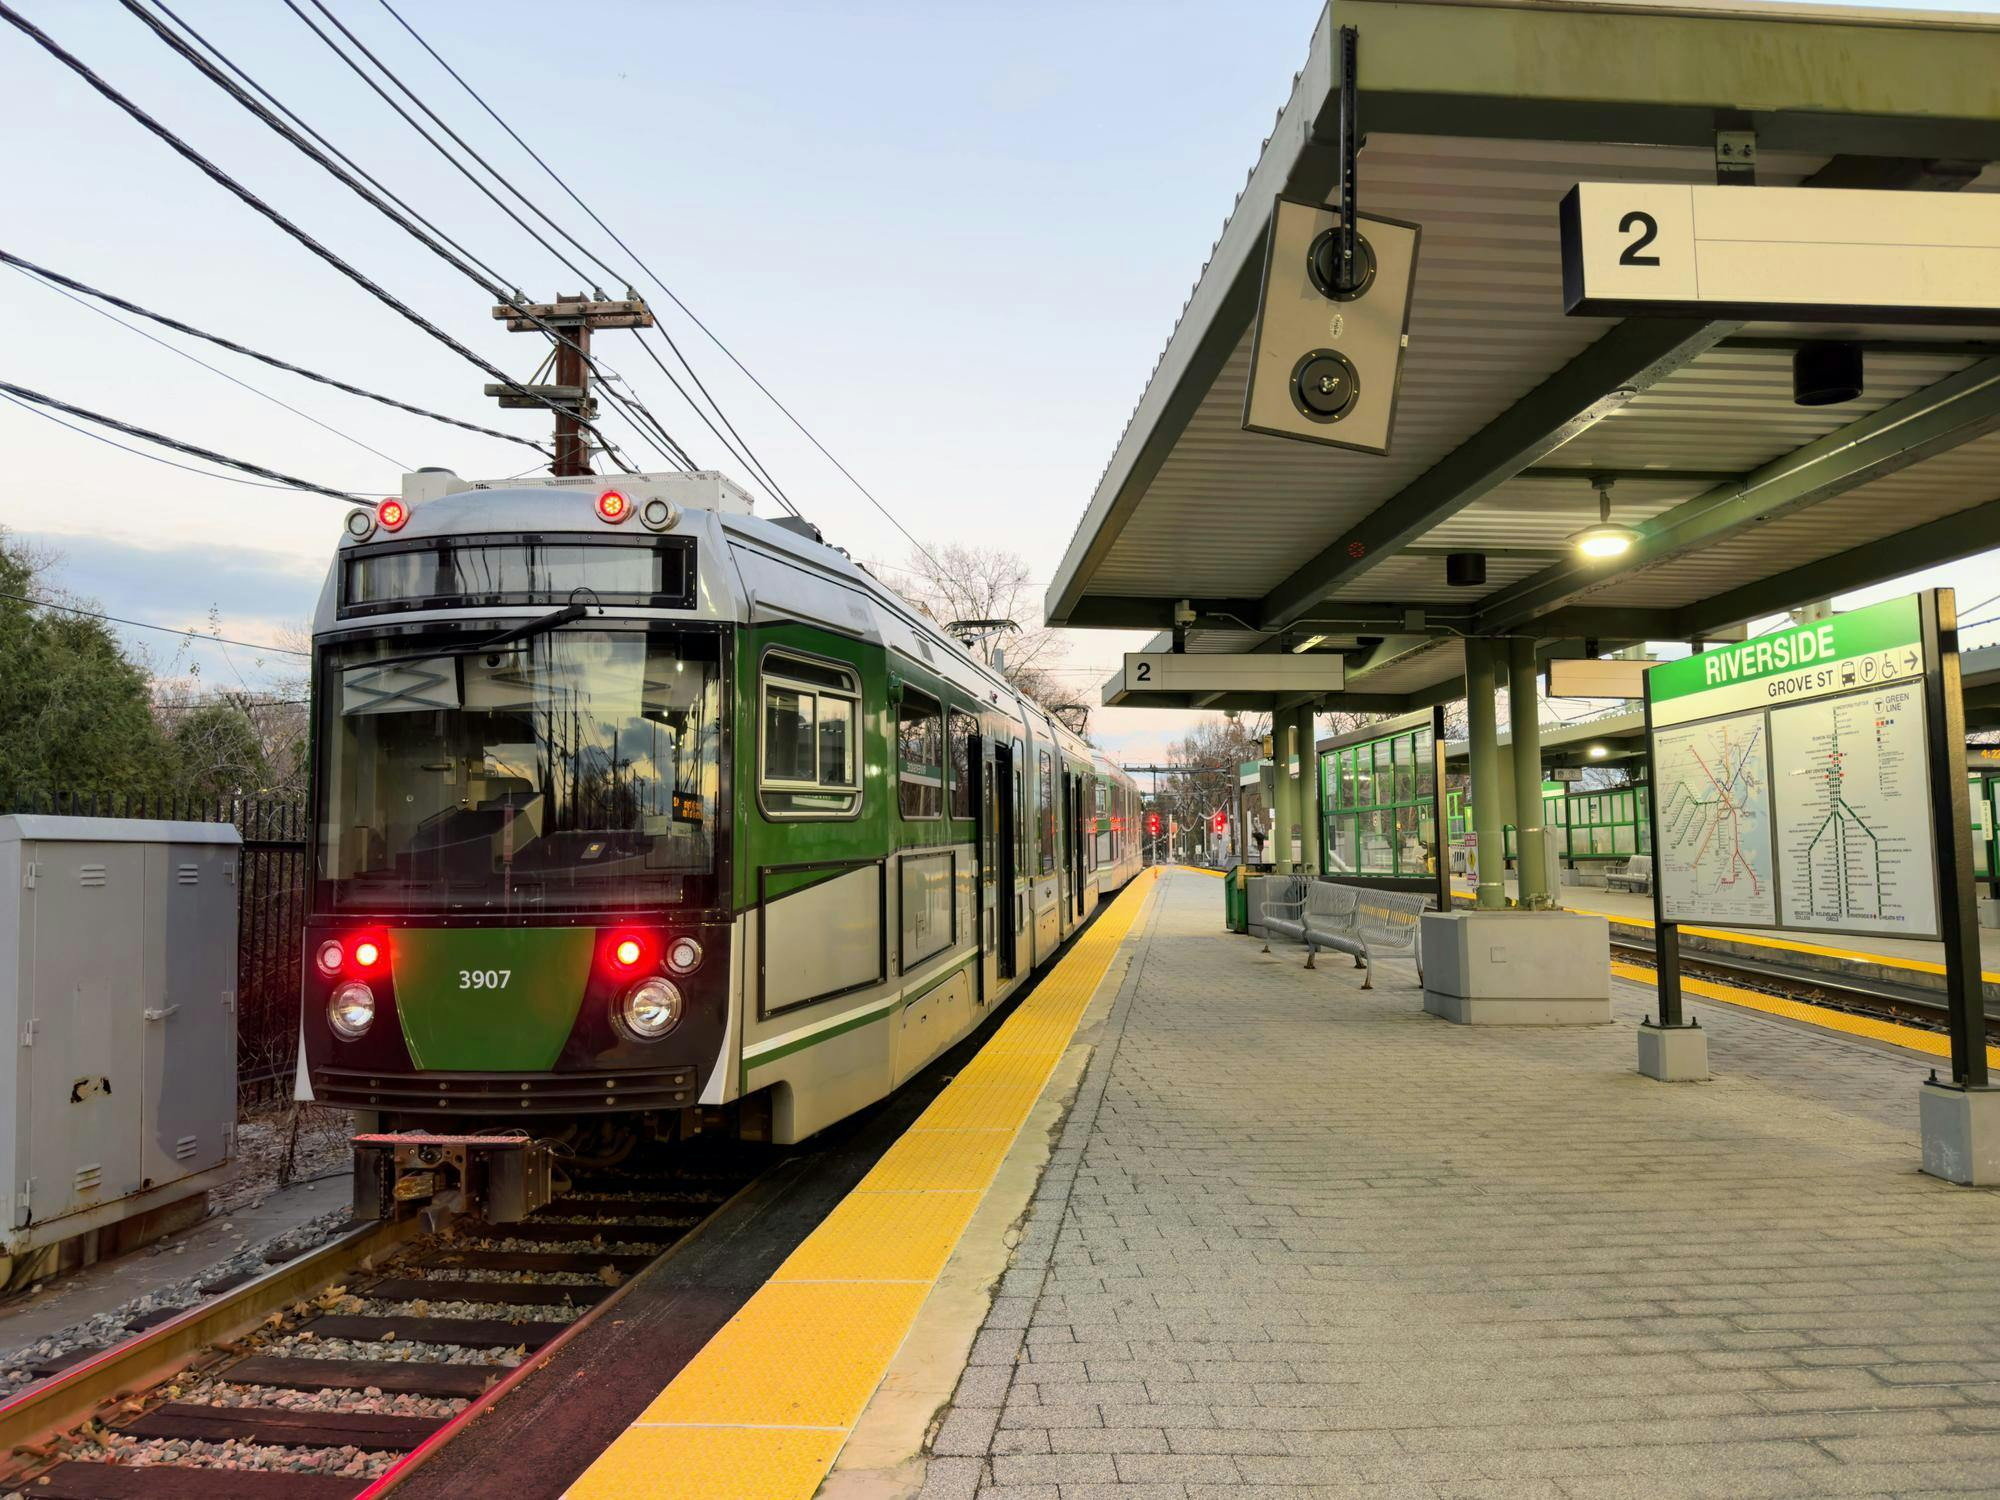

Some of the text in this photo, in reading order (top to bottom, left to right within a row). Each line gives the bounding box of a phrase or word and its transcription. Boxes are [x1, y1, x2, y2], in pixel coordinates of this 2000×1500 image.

[1619, 211, 1660, 266] 2
[1705, 624, 1836, 685] RIVERSIDE
[1137, 662, 1151, 681] 2
[1768, 673, 1813, 697] GROVE
[1817, 670, 1834, 688] ST
[1885, 692, 1910, 704] GREEN
[1886, 703, 1902, 712] LINE
[459, 970, 511, 989] 3907
